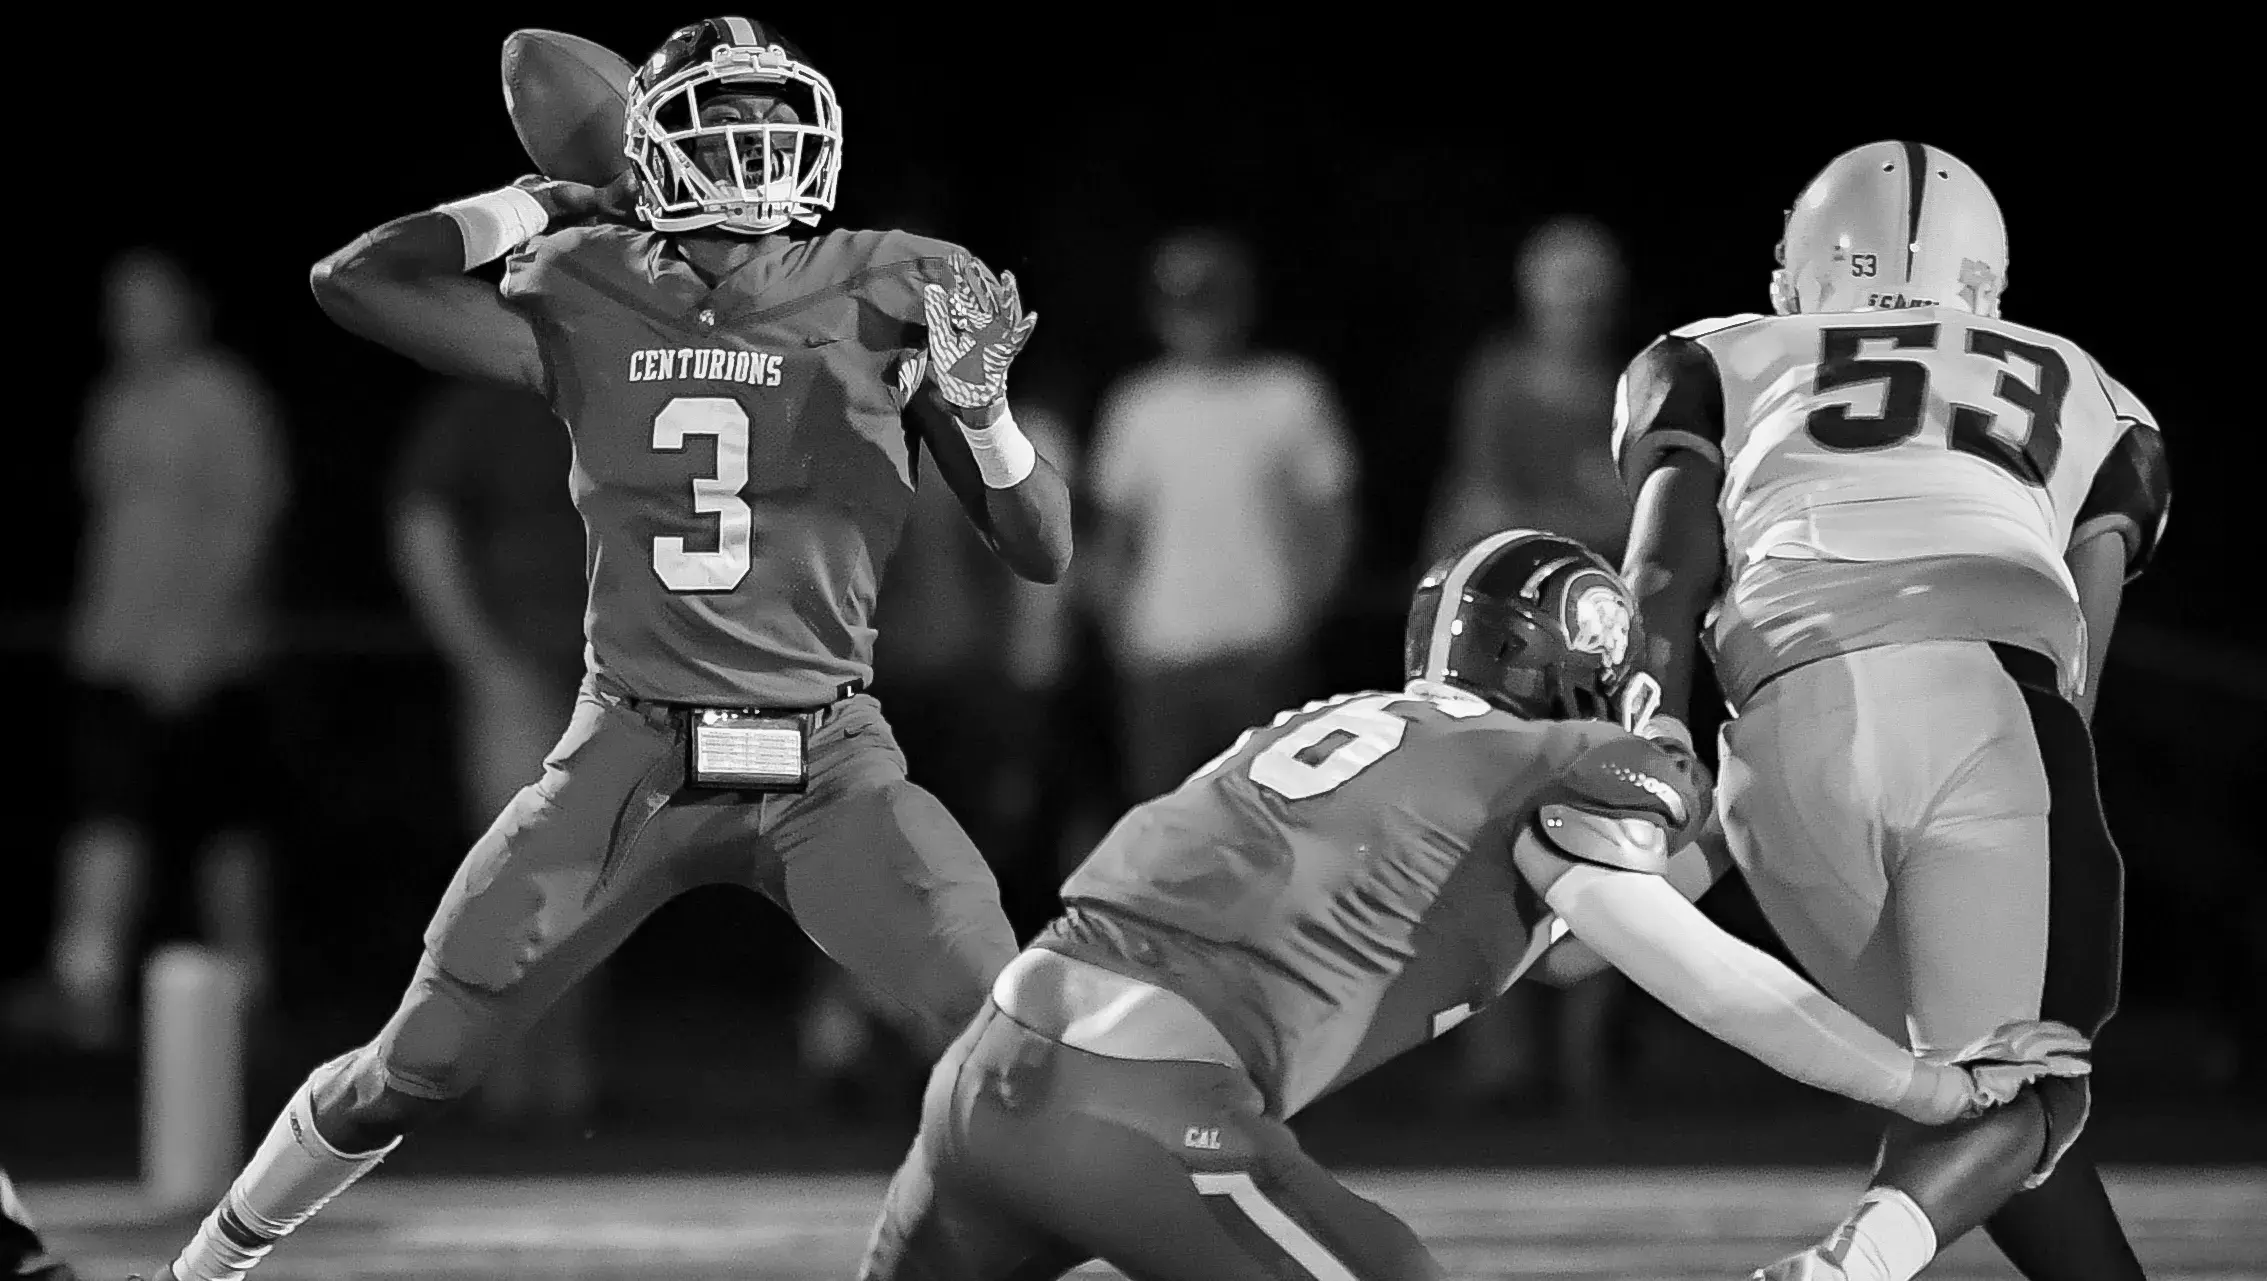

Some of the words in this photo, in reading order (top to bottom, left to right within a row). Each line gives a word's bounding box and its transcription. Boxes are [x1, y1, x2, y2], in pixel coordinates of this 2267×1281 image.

[1851, 254, 1877, 278] 53
[629, 348, 783, 387] CENTURIONS
[1804, 322, 2071, 488] 53
[653, 398, 751, 591] 3
[1185, 1128, 1220, 1150] CAL
